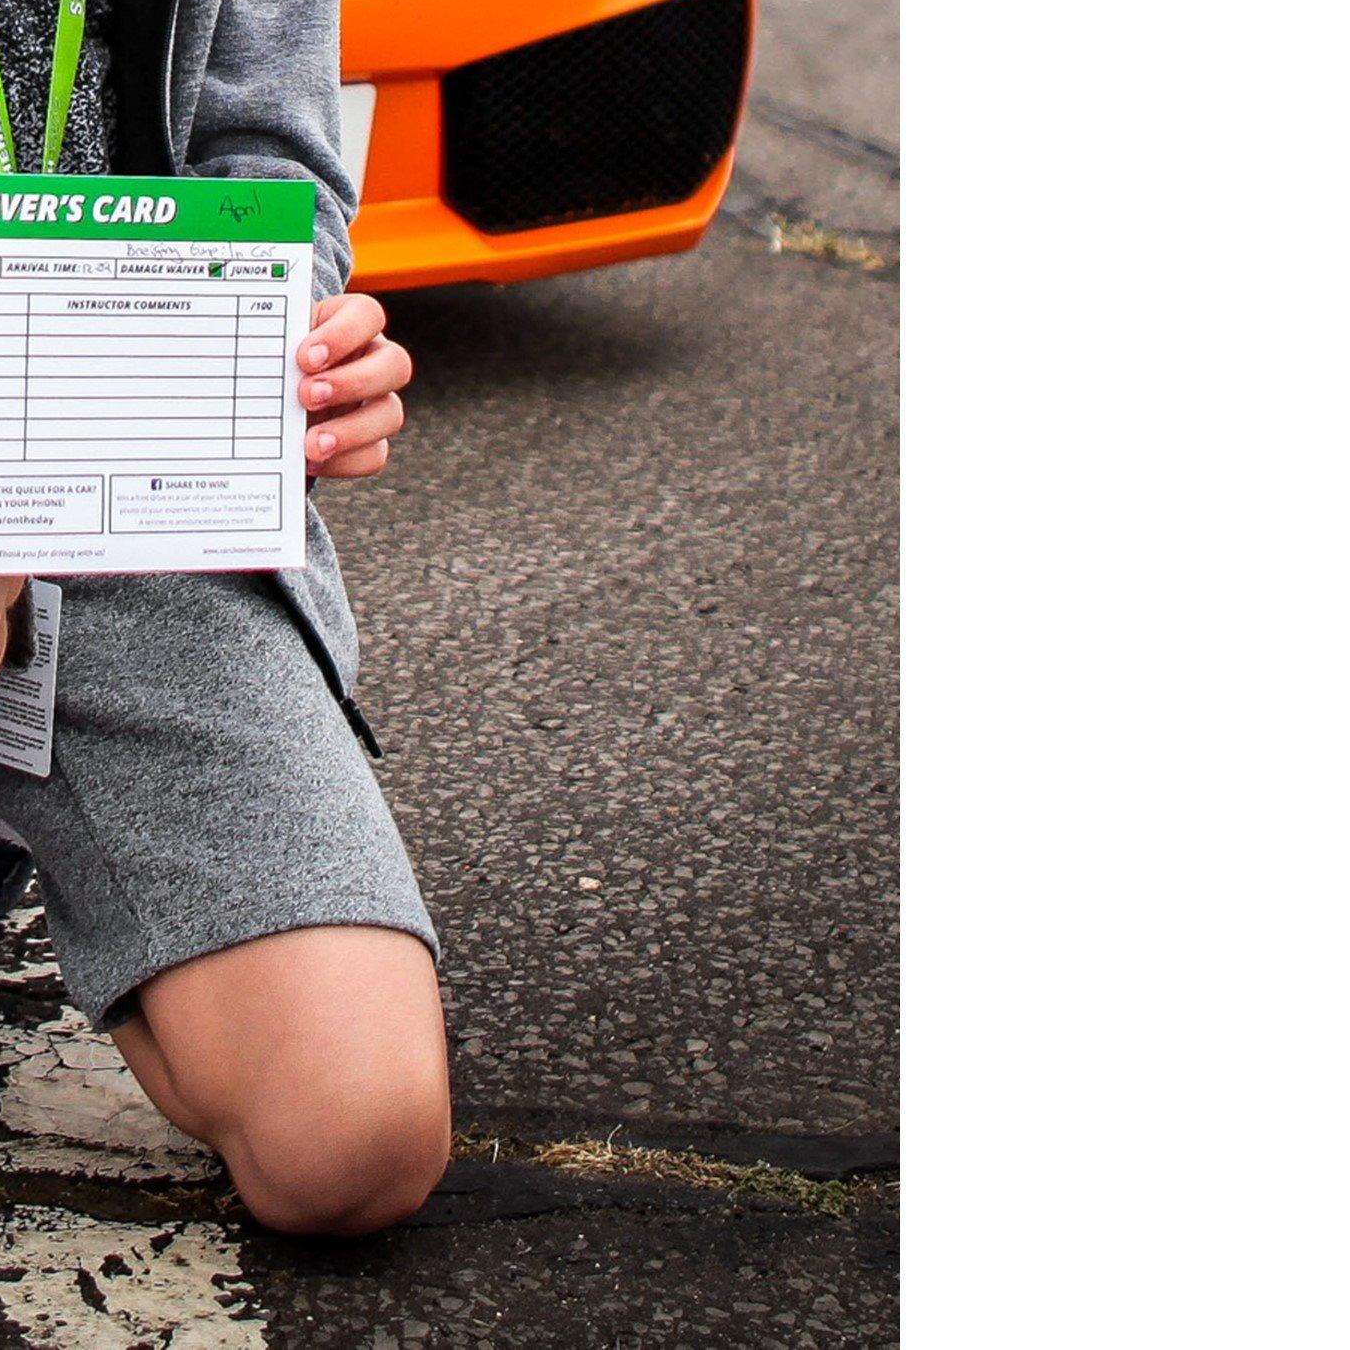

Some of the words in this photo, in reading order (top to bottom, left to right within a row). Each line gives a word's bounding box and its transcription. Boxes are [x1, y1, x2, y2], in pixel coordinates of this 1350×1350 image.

[92, 195, 177, 224] CARD
[219, 189, 261, 224] April
[6, 261, 49, 272] ARRIVAL
[52, 263, 81, 273] TIME:
[120, 264, 164, 274] DAMAGE
[166, 265, 204, 274] WAIVER
[230, 266, 267, 277] JUNIOR
[66, 300, 131, 310] INSTRUCTOR
[134, 301, 192, 311] COMMENTS
[250, 301, 273, 311] /100
[165, 481, 193, 489] SHARE
[196, 481, 207, 489] TO
[208, 480, 229, 489] WIN!
[15, 486, 45, 495] QUEUE
[75, 485, 97, 494] CAR?
[31, 500, 65, 508] PHONE!
[37, 550, 49, 559] for
[50, 549, 75, 558] driving
[77, 549, 93, 557] with
